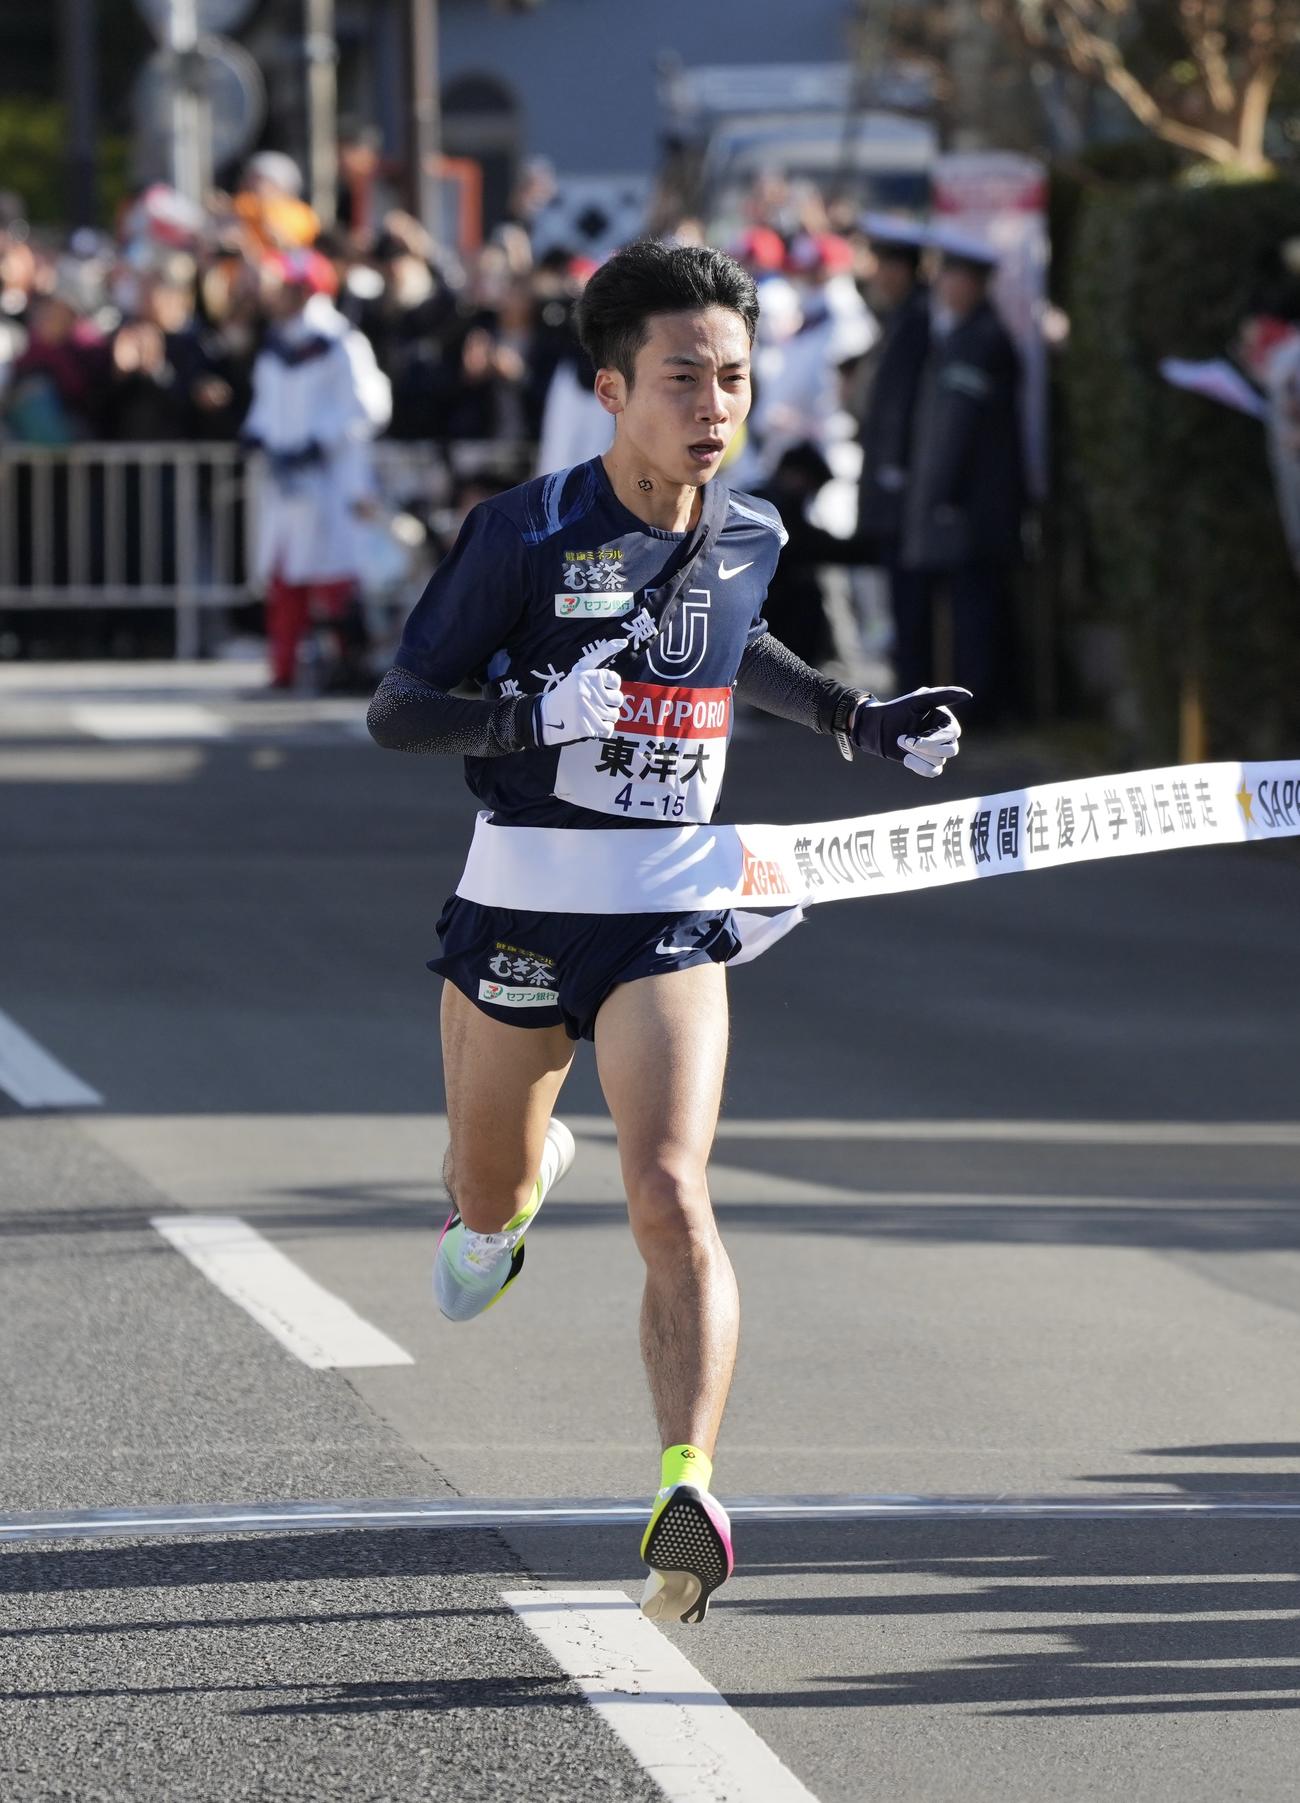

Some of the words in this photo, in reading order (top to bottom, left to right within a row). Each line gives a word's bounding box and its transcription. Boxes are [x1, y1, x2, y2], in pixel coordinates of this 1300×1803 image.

[563, 561, 627, 591] むぎ茶
[618, 694, 726, 729] SAPPORO
[594, 736, 710, 784] 東洋大
[614, 782, 685, 817] 4-15
[489, 953, 557, 985] むぎ茶
[506, 991, 556, 1002] セブン銀行
